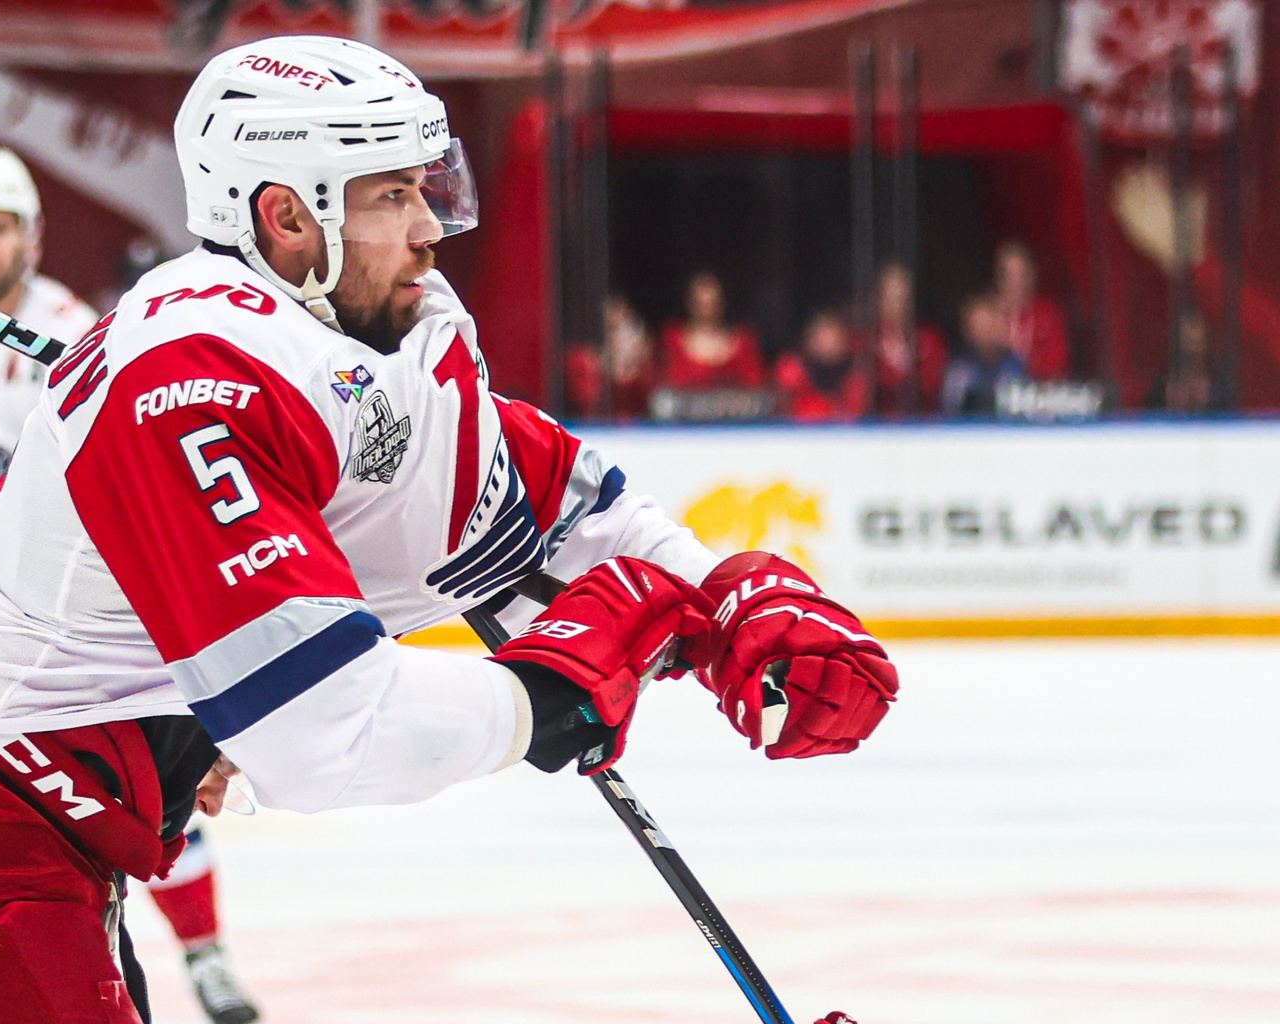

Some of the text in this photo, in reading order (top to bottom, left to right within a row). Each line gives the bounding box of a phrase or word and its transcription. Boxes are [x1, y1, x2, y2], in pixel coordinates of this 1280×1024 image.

[237, 55, 334, 91] FONBET
[422, 118, 448, 140] сога
[135, 378, 261, 426] FONBET
[176, 422, 262, 526] 5
[861, 503, 1247, 548] GISLAVED
[218, 533, 309, 587] ПСМ
